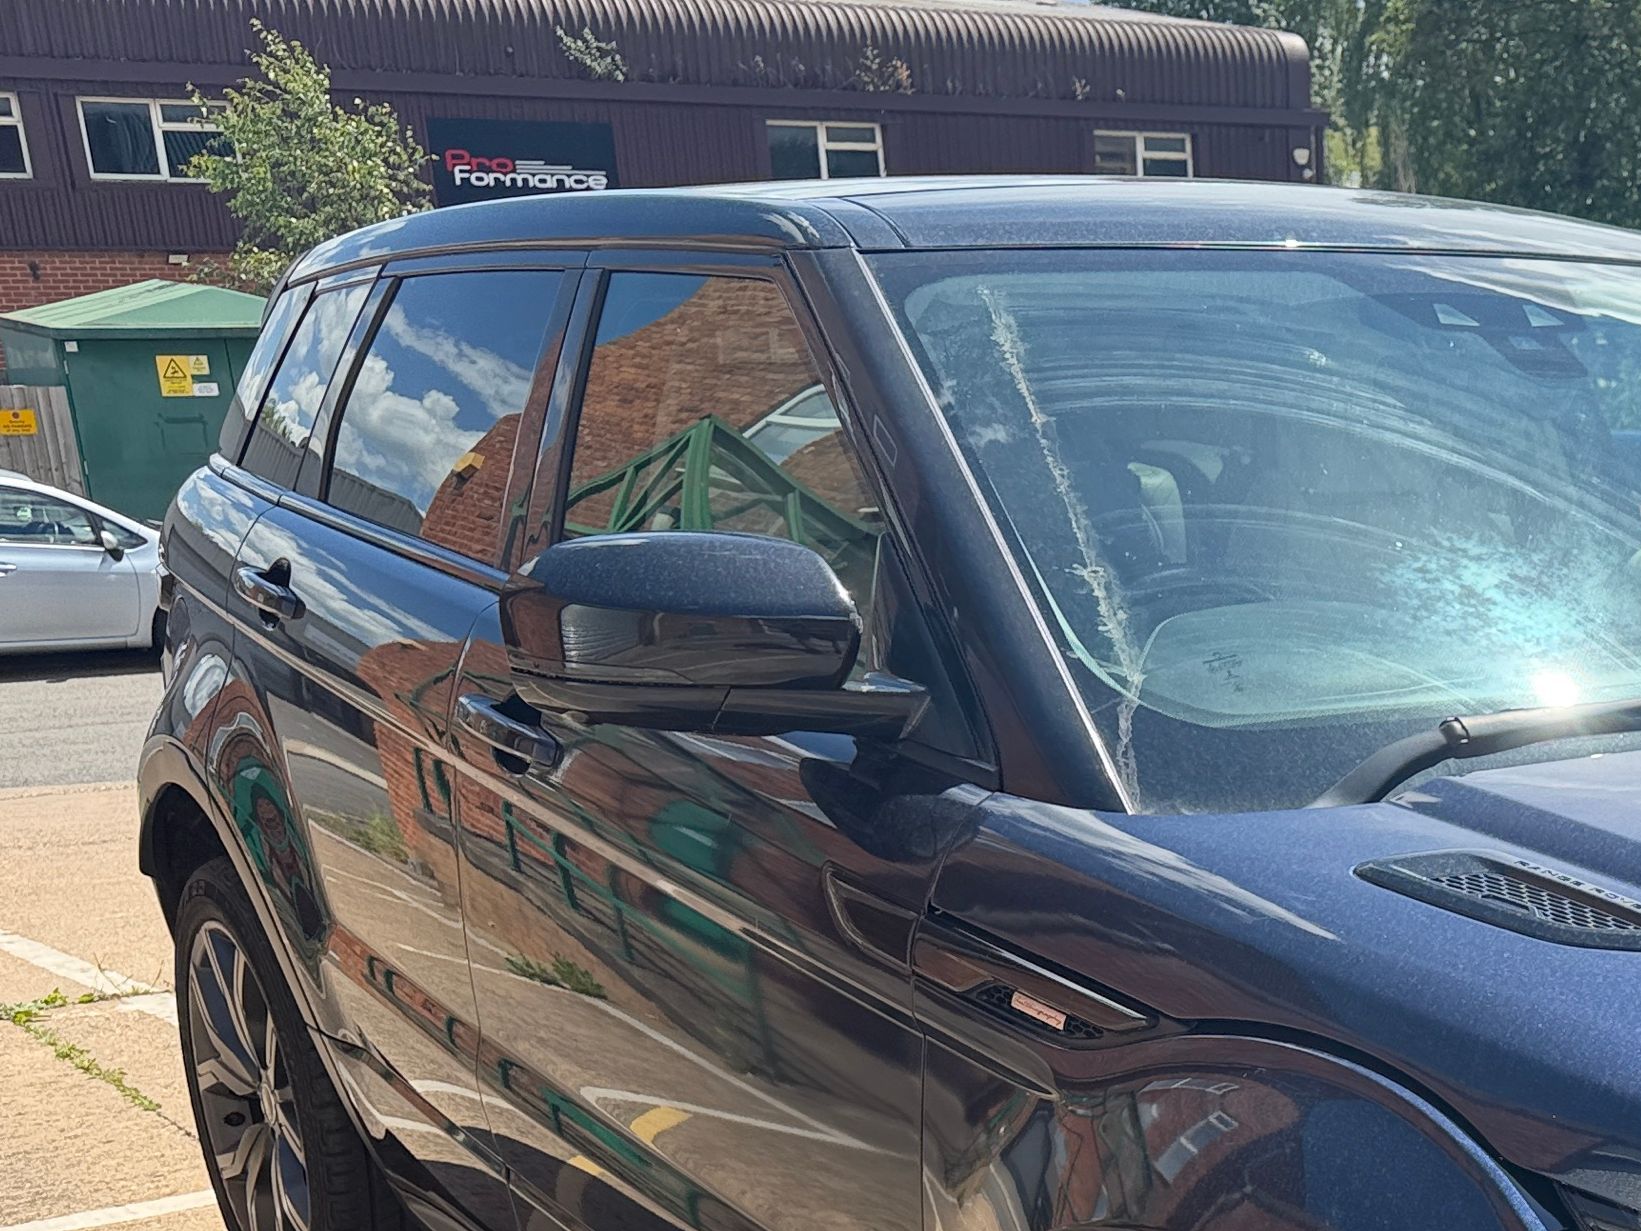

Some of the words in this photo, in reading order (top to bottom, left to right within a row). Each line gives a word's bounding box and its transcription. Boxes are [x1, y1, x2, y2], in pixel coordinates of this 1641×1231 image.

[445, 149, 514, 173] Pro
[453, 165, 608, 190] Formance
[1514, 860, 1586, 887] RANGE
